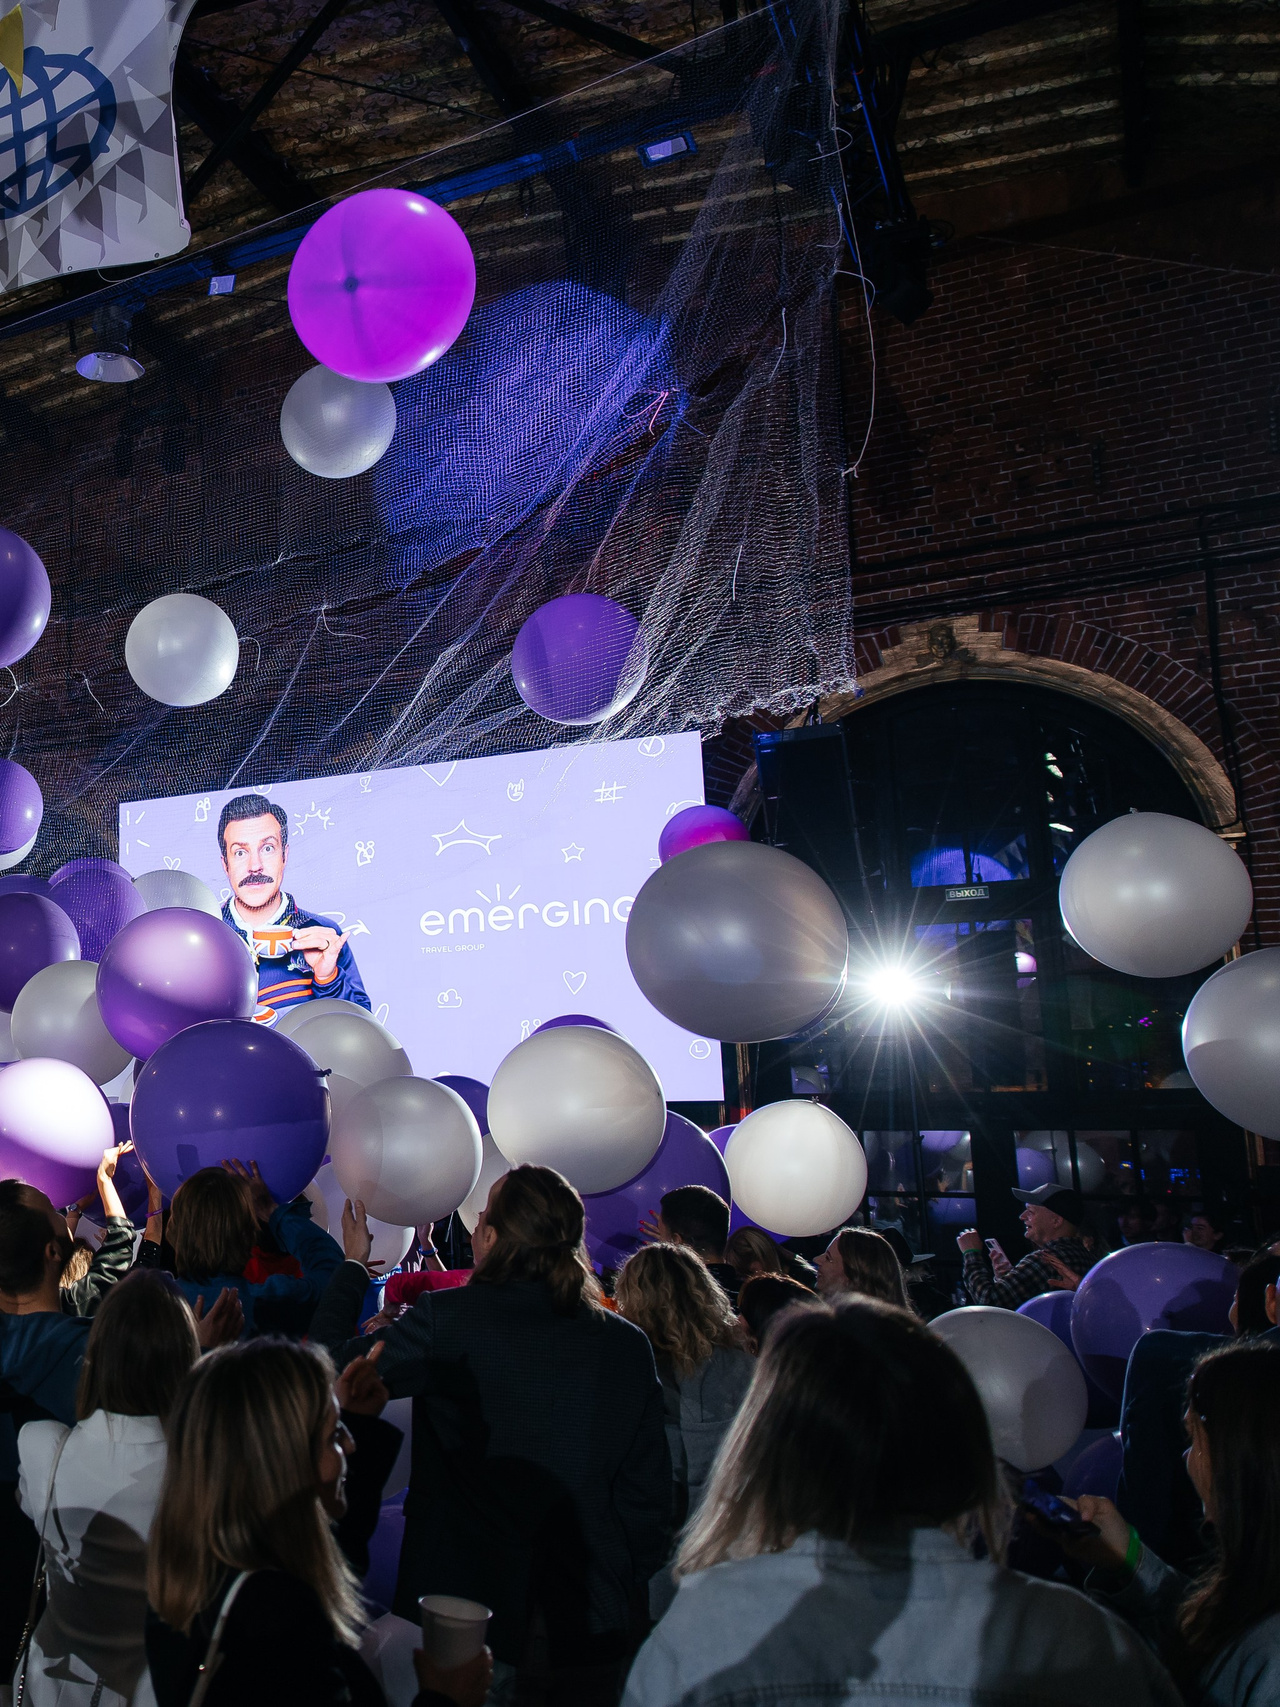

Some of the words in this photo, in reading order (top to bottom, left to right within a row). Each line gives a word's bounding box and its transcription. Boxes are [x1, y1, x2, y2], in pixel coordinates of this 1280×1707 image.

[949, 888, 986, 898] ВЫХОД
[420, 945, 452, 955] TRAVEL
[454, 943, 485, 953] GROUP
